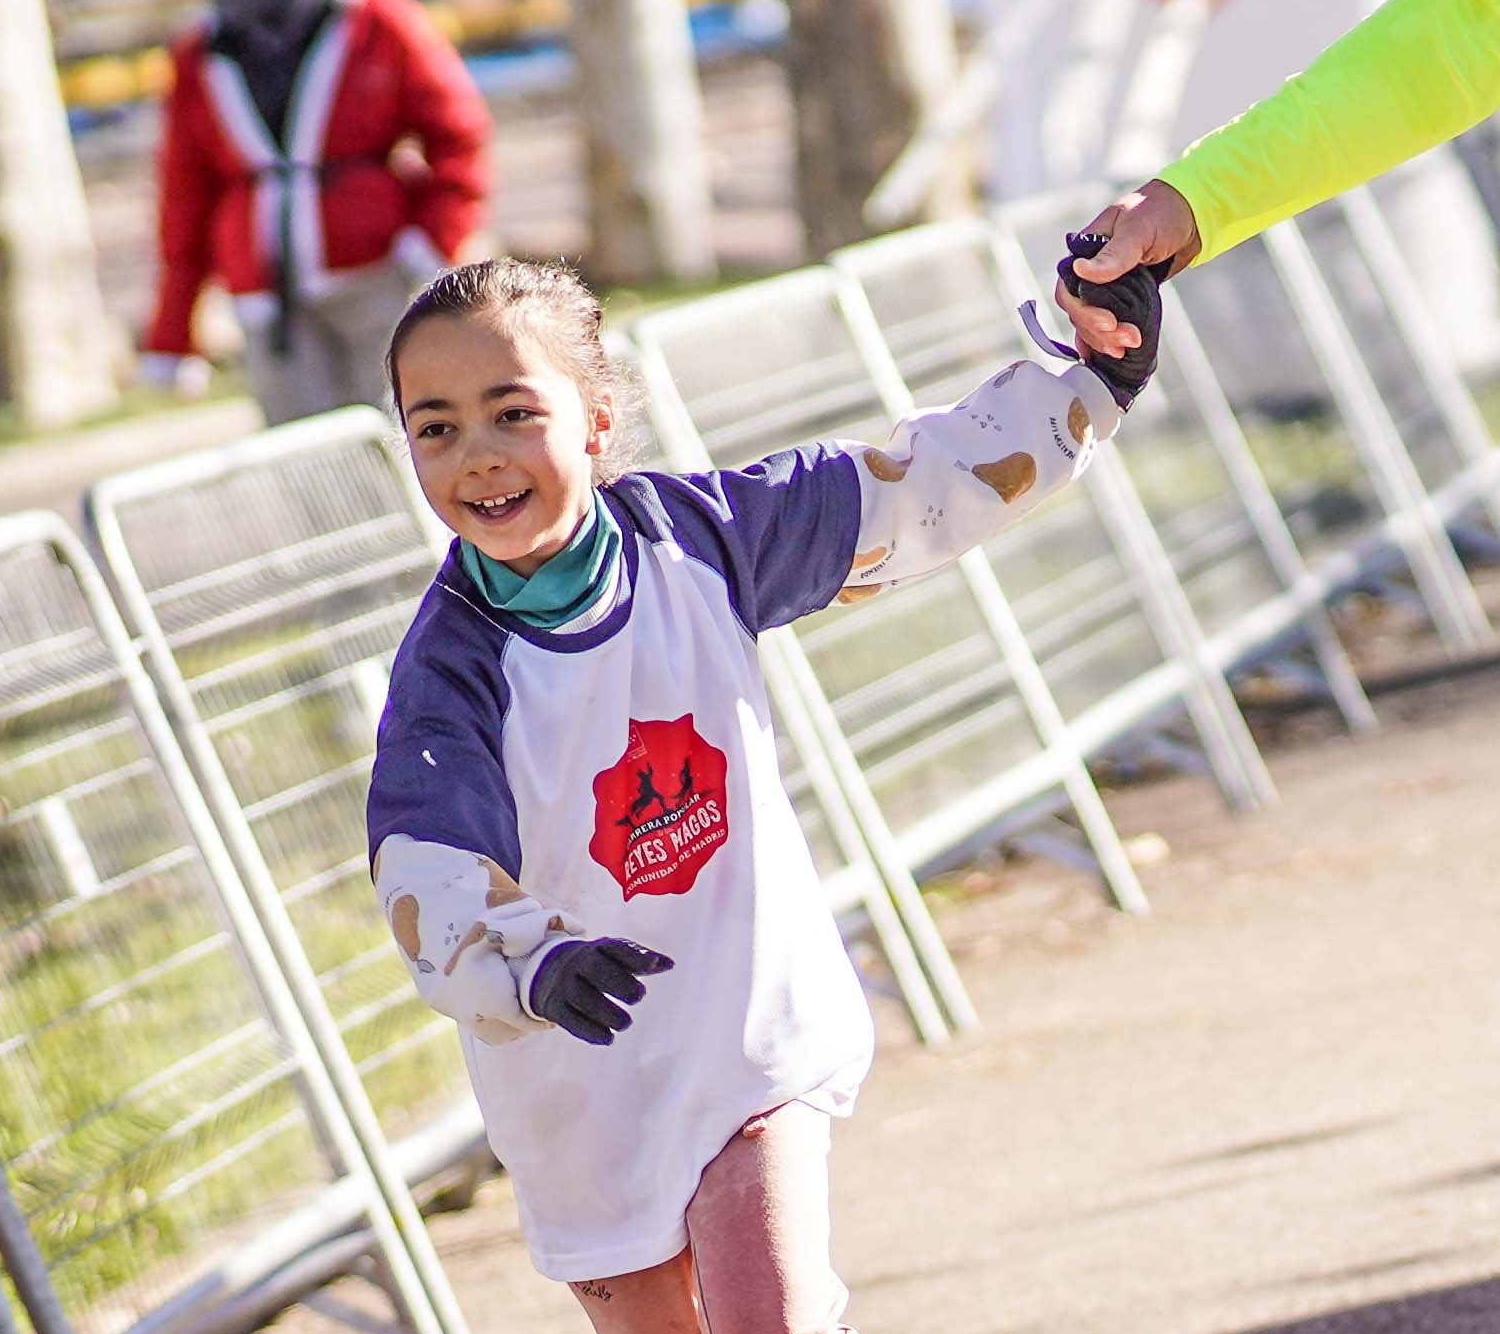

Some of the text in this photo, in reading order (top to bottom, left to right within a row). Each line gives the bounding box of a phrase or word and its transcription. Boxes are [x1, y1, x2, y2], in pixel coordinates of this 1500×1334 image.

[624, 799, 721, 882] REYES MAGOS
[627, 817, 662, 848] ARRERA
